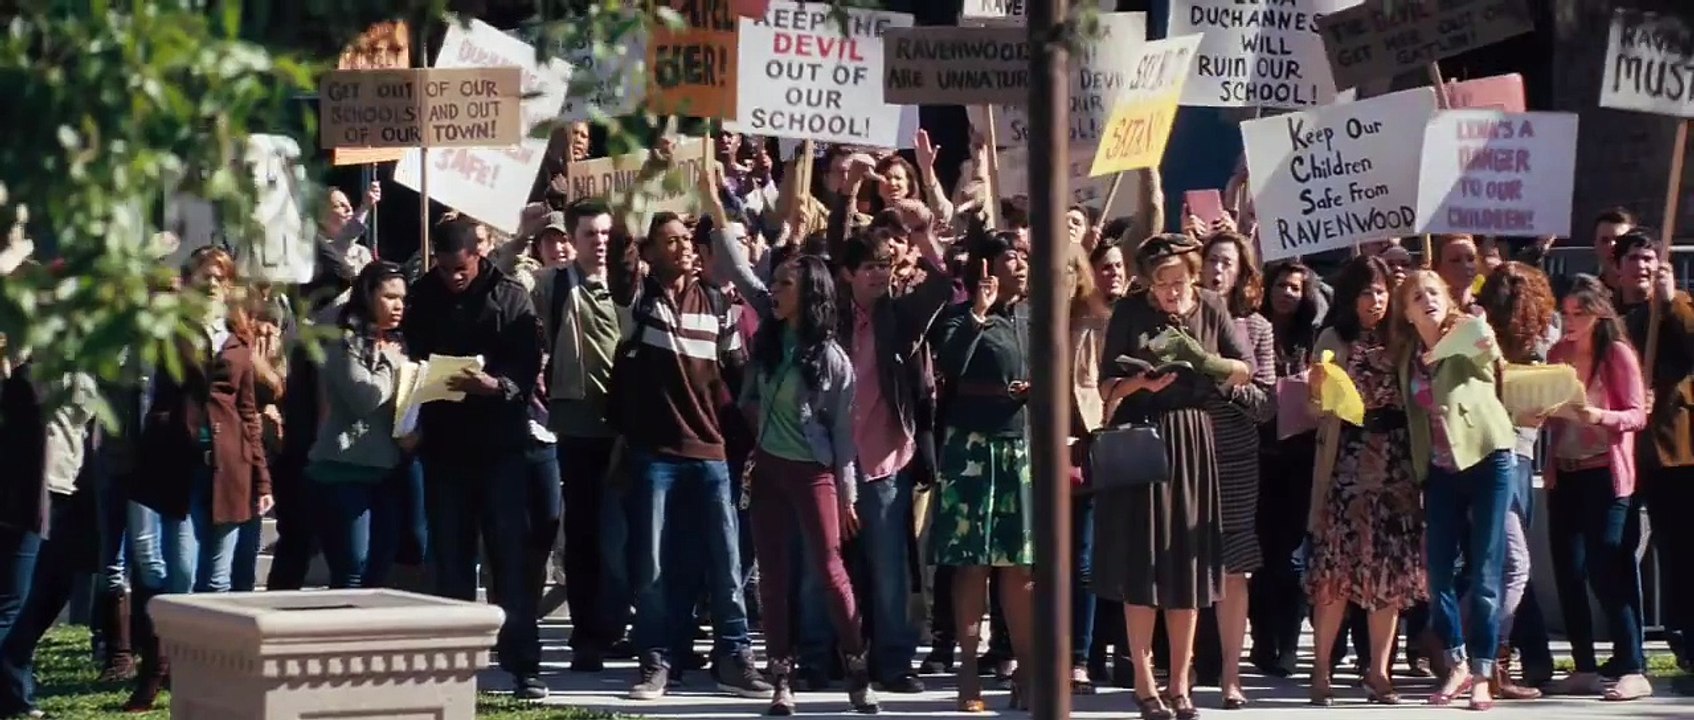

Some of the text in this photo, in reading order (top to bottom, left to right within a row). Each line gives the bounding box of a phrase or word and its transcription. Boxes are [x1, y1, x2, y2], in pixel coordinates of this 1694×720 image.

[1190, 6, 1323, 34] DUCHANNES
[772, 33, 865, 62] DEVIL
[1241, 34, 1293, 56] WILL
[765, 59, 869, 86] OUT OF
[888, 64, 925, 89] ARE
[1256, 57, 1303, 80] OUR
[377, 81, 414, 99] OUT
[424, 80, 450, 98] OF
[459, 79, 498, 98] OUR
[785, 87, 843, 110] OUR
[1219, 80, 1318, 106] SCHOOL!
[429, 101, 458, 122] AND
[466, 99, 502, 119] OUT
[344, 119, 497, 144] OF OUR TOWN!
[750, 108, 871, 139] SCHOOL!
[1287, 116, 1383, 151] Keep Our
[1518, 119, 1536, 139] A
[1290, 150, 1373, 184] Children
[1299, 181, 1389, 215] Safe From
[1460, 177, 1523, 202] TO OUR
[1277, 205, 1416, 250] RAVENWOOD
